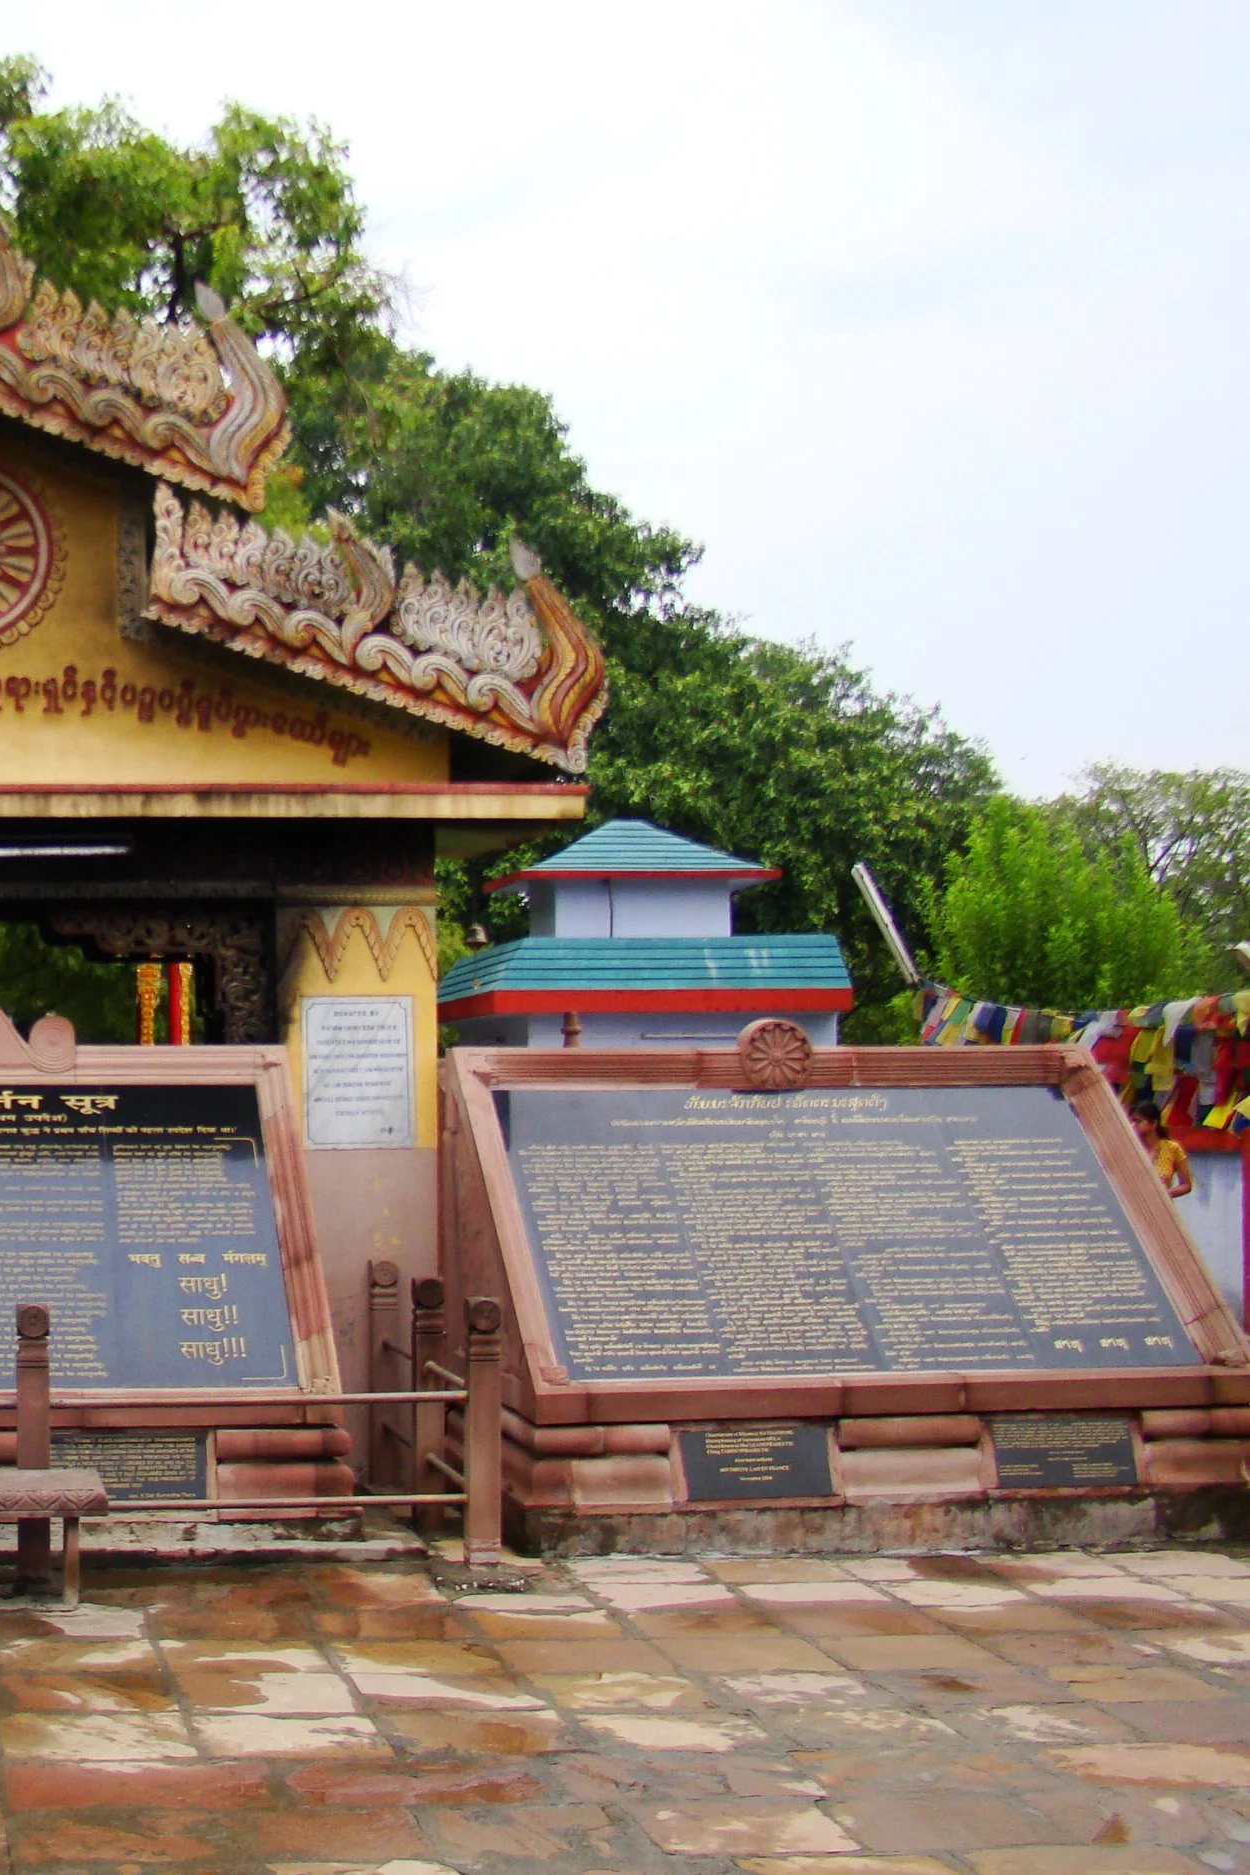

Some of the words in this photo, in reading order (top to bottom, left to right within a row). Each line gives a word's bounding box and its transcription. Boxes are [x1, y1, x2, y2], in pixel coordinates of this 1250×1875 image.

[59, 1094, 120, 1115] सूत्र
[128, 1253, 162, 1268] भवतु
[177, 1273, 228, 1300] साधु!
[179, 1305, 239, 1332] साधु!!
[178, 1337, 247, 1366] साधु!!!
